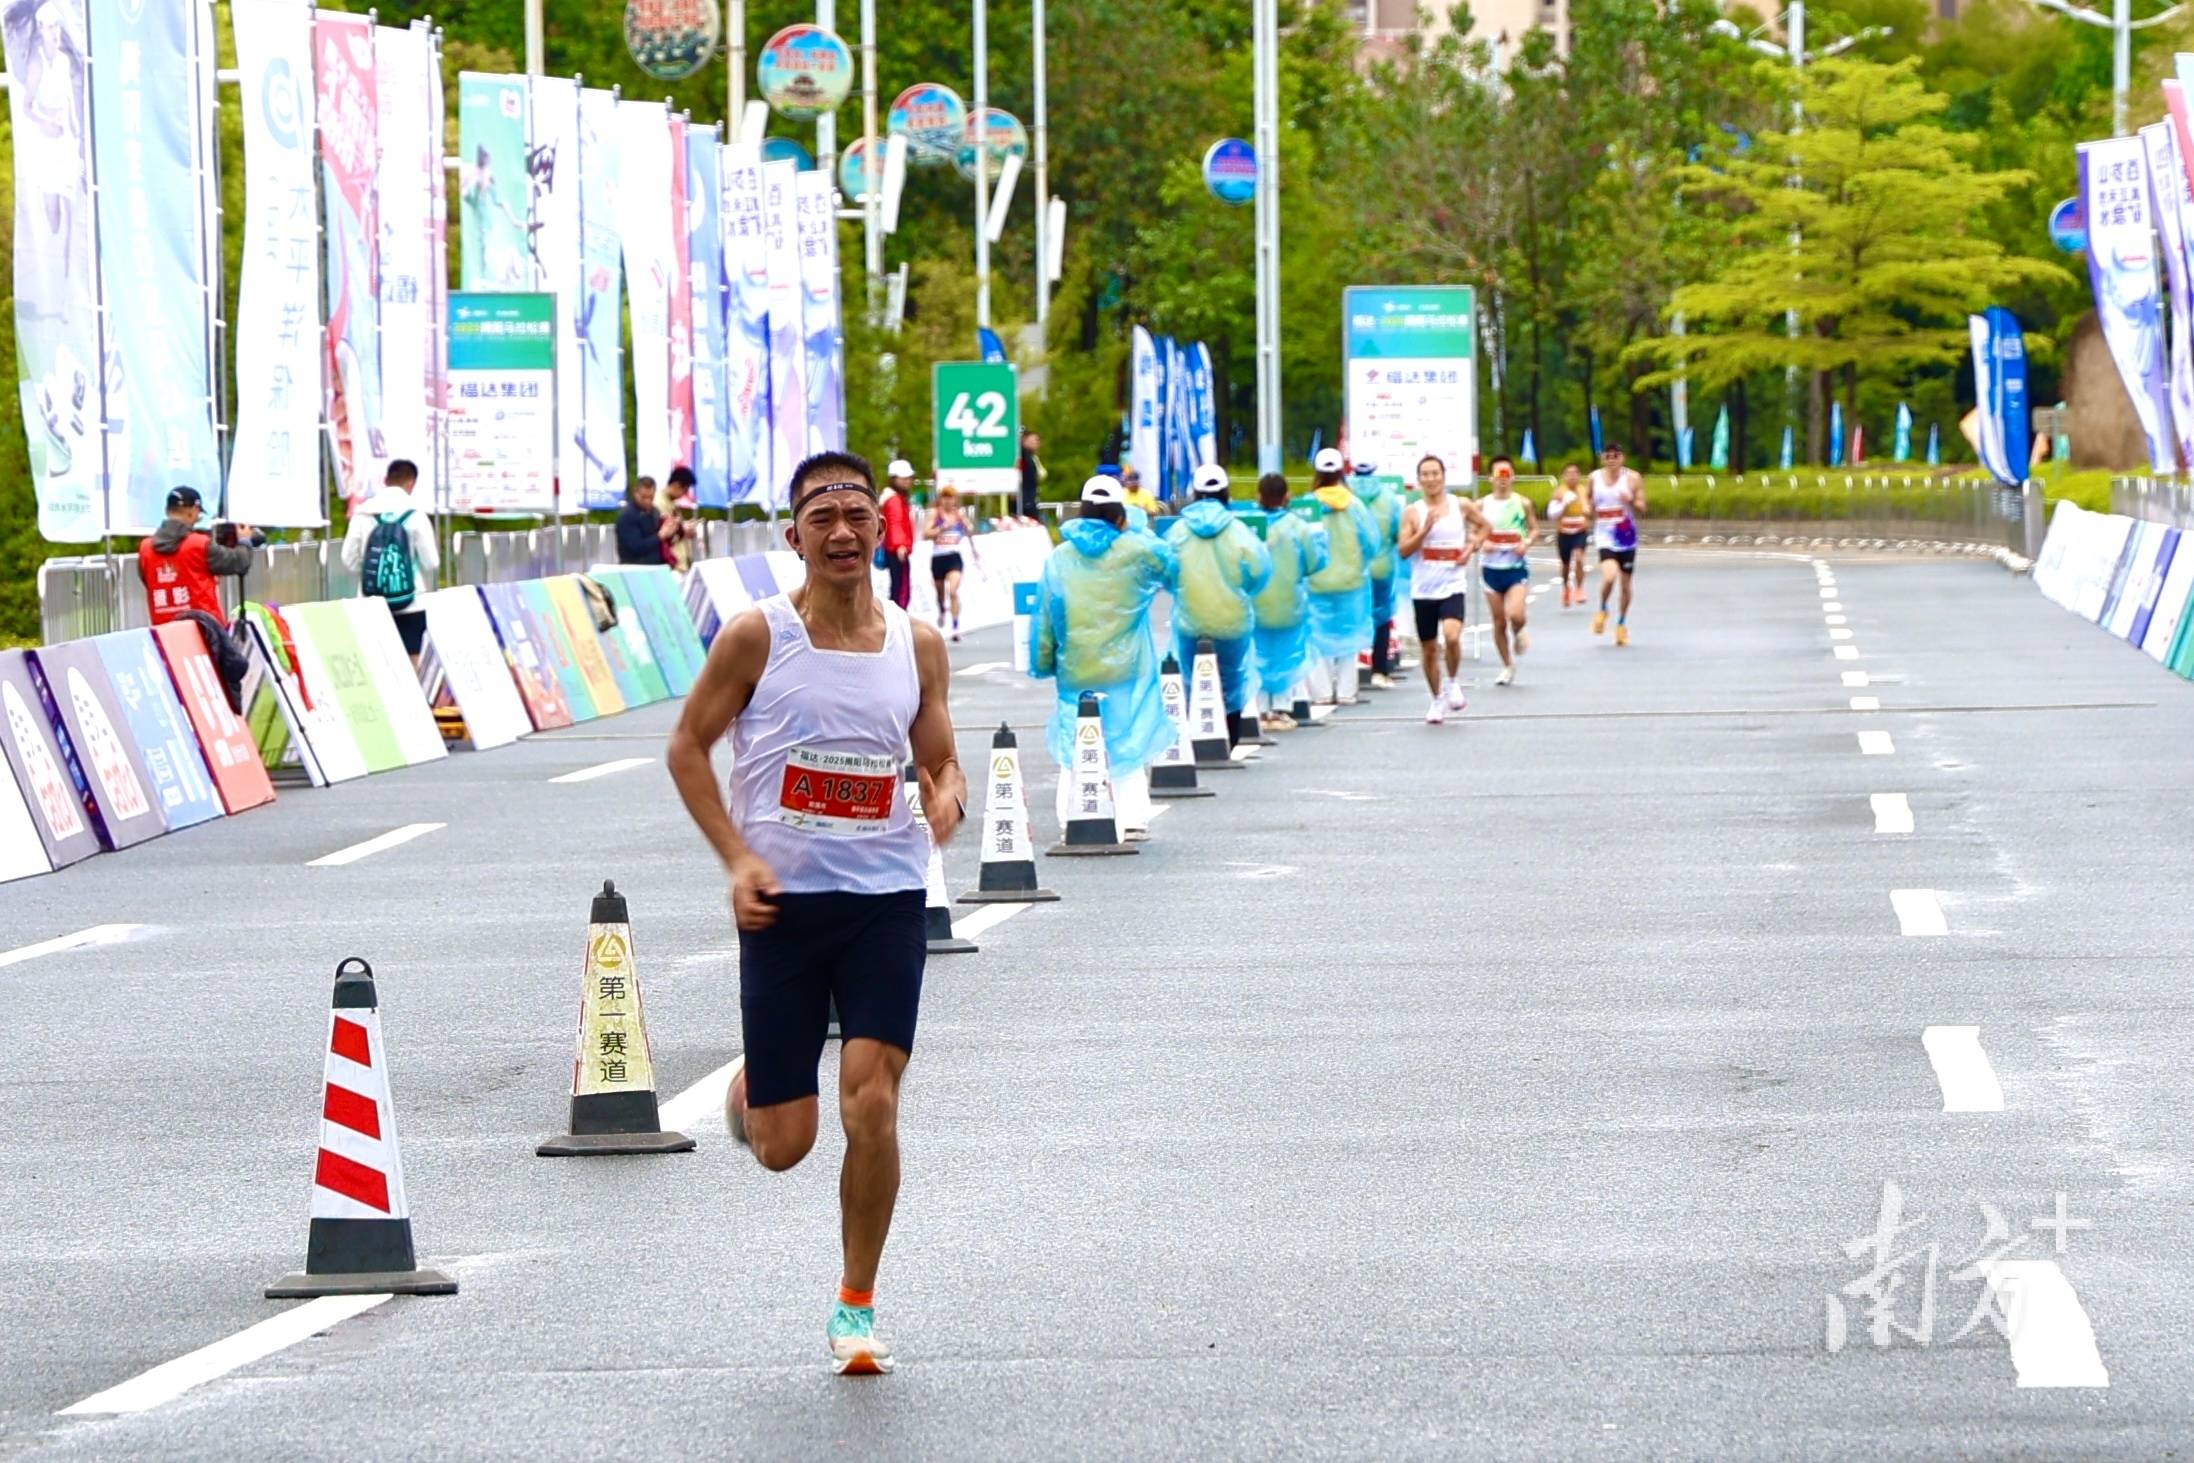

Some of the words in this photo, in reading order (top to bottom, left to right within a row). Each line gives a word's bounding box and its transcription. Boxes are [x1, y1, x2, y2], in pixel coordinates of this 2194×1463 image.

[460, 381, 539, 398] 福达集团
[943, 391, 1009, 438] 42
[962, 438, 994, 458] km
[790, 773, 814, 799] A
[821, 777, 885, 805] 1837
[1081, 748, 1099, 813] 第一赛道
[994, 782, 1015, 855] 第一赛道
[598, 975, 629, 1083] 第一赛道
